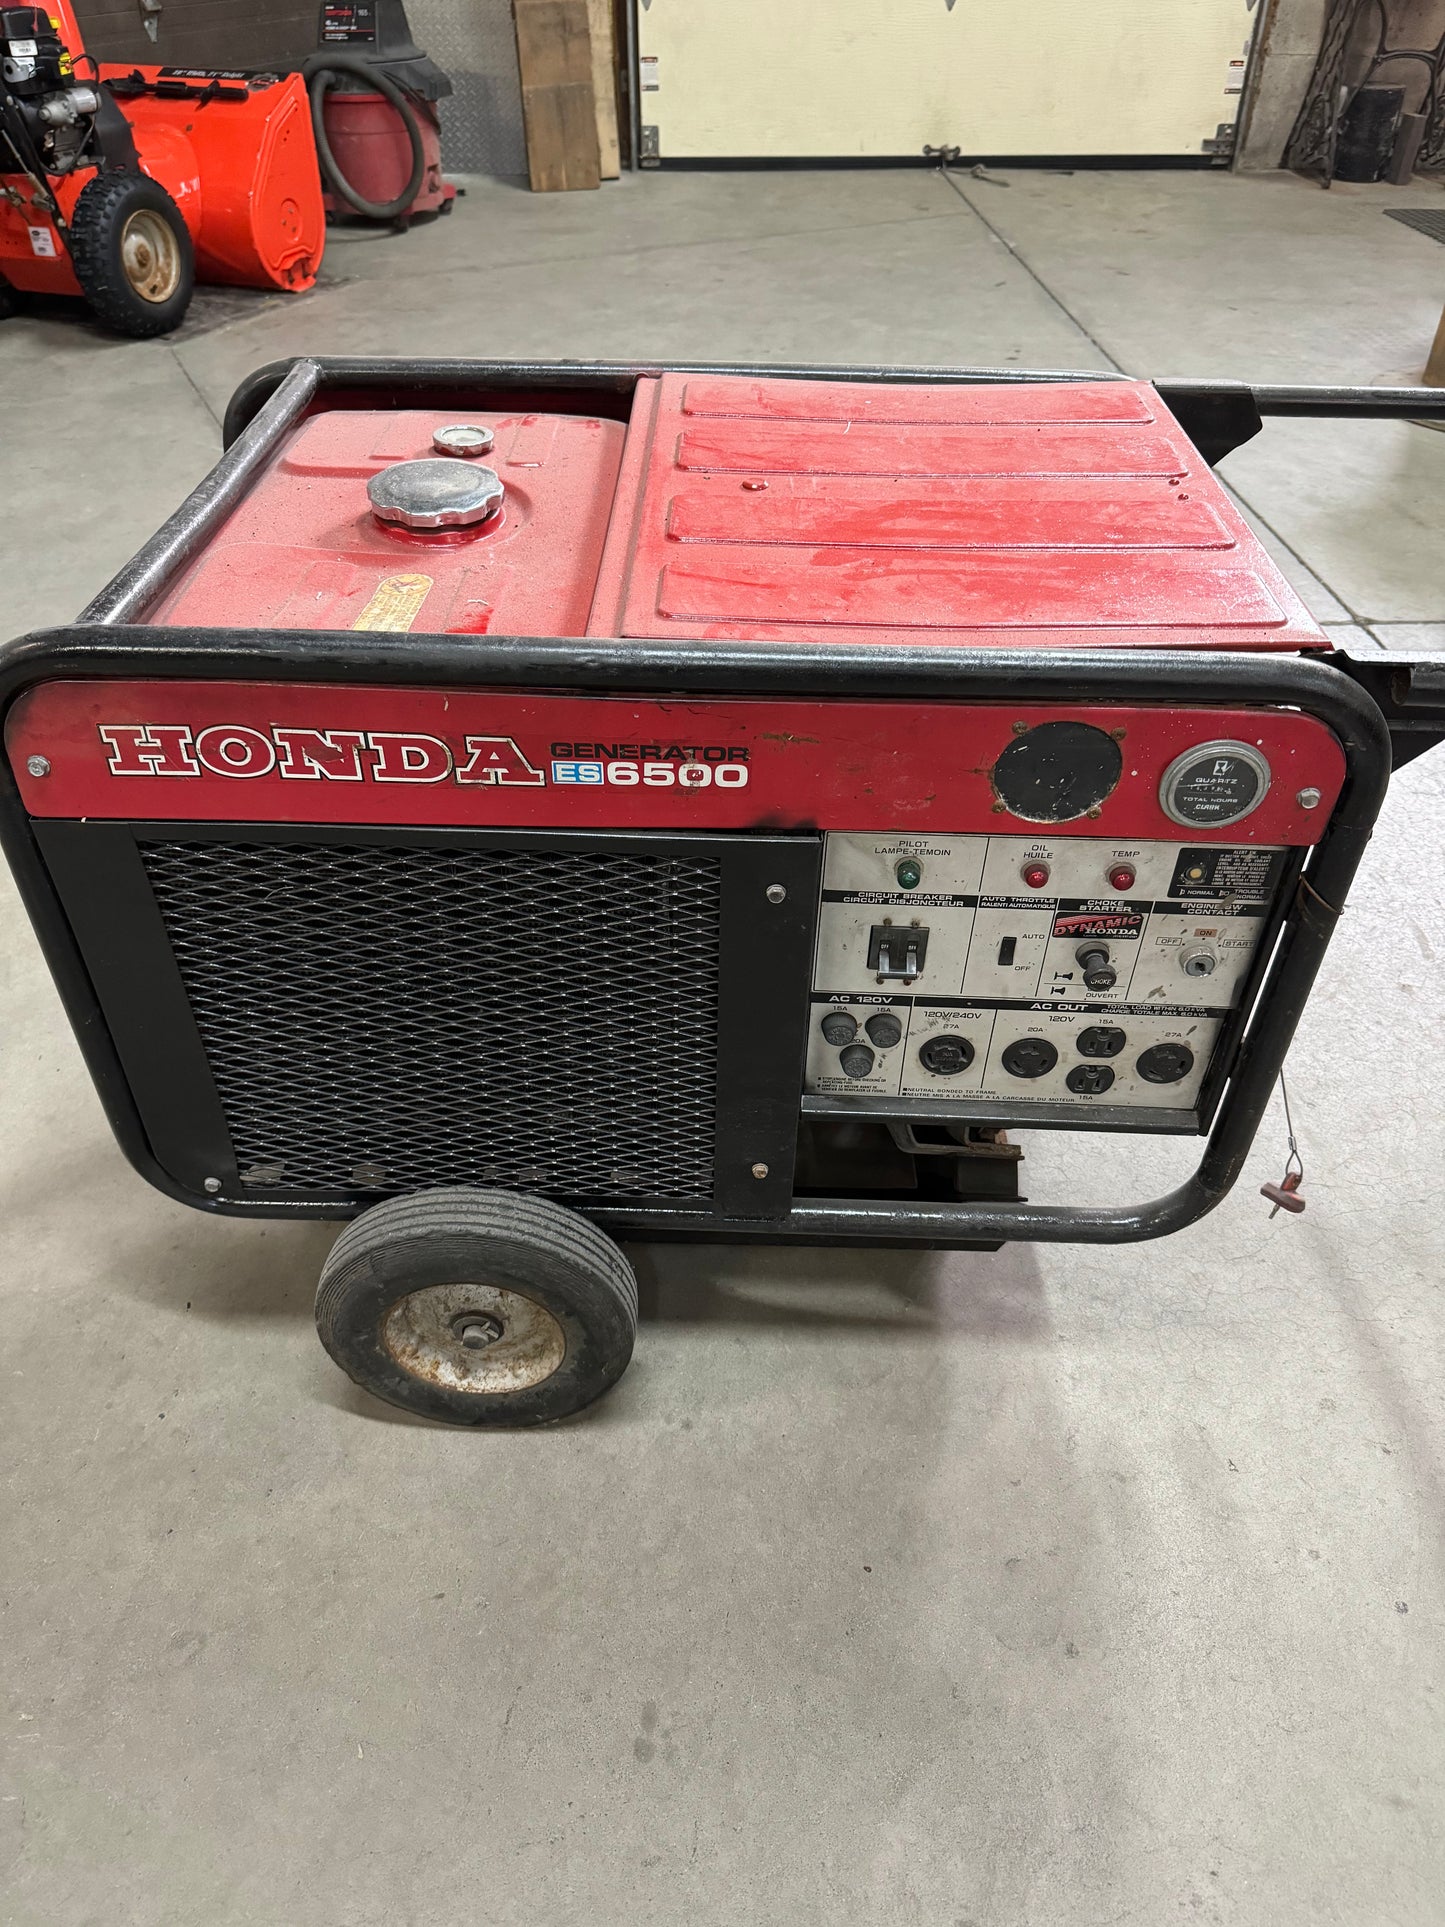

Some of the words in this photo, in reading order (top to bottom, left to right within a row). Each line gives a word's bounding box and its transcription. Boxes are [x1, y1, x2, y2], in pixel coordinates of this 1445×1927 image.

[97, 723, 547, 787] HONDA
[550, 741, 750, 762] GENERATOR
[1195, 777, 1238, 785] QUARTZ
[898, 840, 929, 848] PILOT
[1031, 844, 1049, 852] OIL
[874, 847, 951, 856] LAMPE-TEMOIN
[1112, 850, 1140, 858] TEMP
[843, 896, 883, 904] CIRCUIT
[889, 899, 964, 907] DISJONCTEUR
[1053, 914, 1142, 937] DYNAMIC
[1083, 927, 1138, 936] HONDA
[857, 996, 893, 1004] 120V
[923, 1011, 982, 1020] 120V/240V
[1048, 1015, 1076, 1023] 120V
